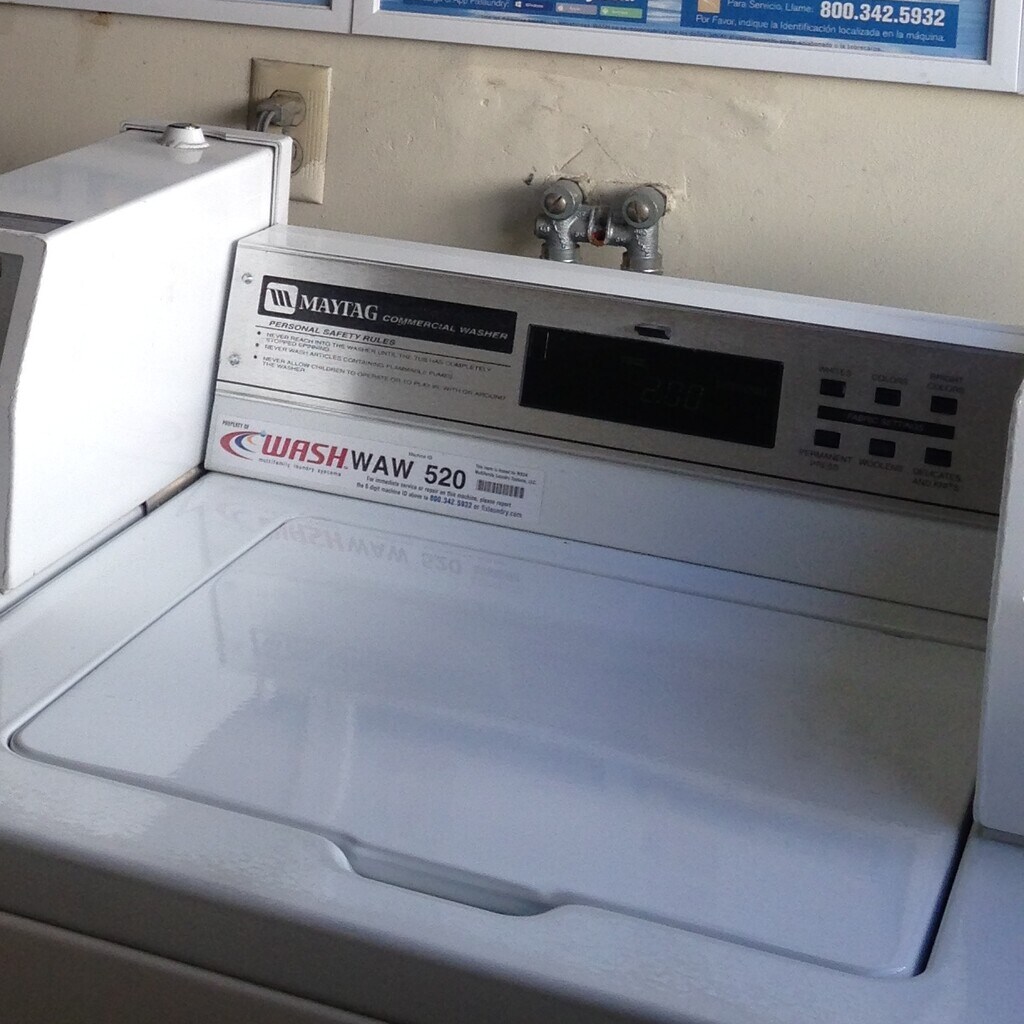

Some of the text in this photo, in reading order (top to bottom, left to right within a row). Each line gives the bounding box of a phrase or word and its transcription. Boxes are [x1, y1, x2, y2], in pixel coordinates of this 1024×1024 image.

[820, 0, 945, 26] 800.342.5932
[269, 320, 396, 346] PERSONAL SAFETY RULES
[299, 294, 508, 340] MAYTAG COMMERCIAL WASHER
[261, 433, 466, 490] WASH WAW 520
